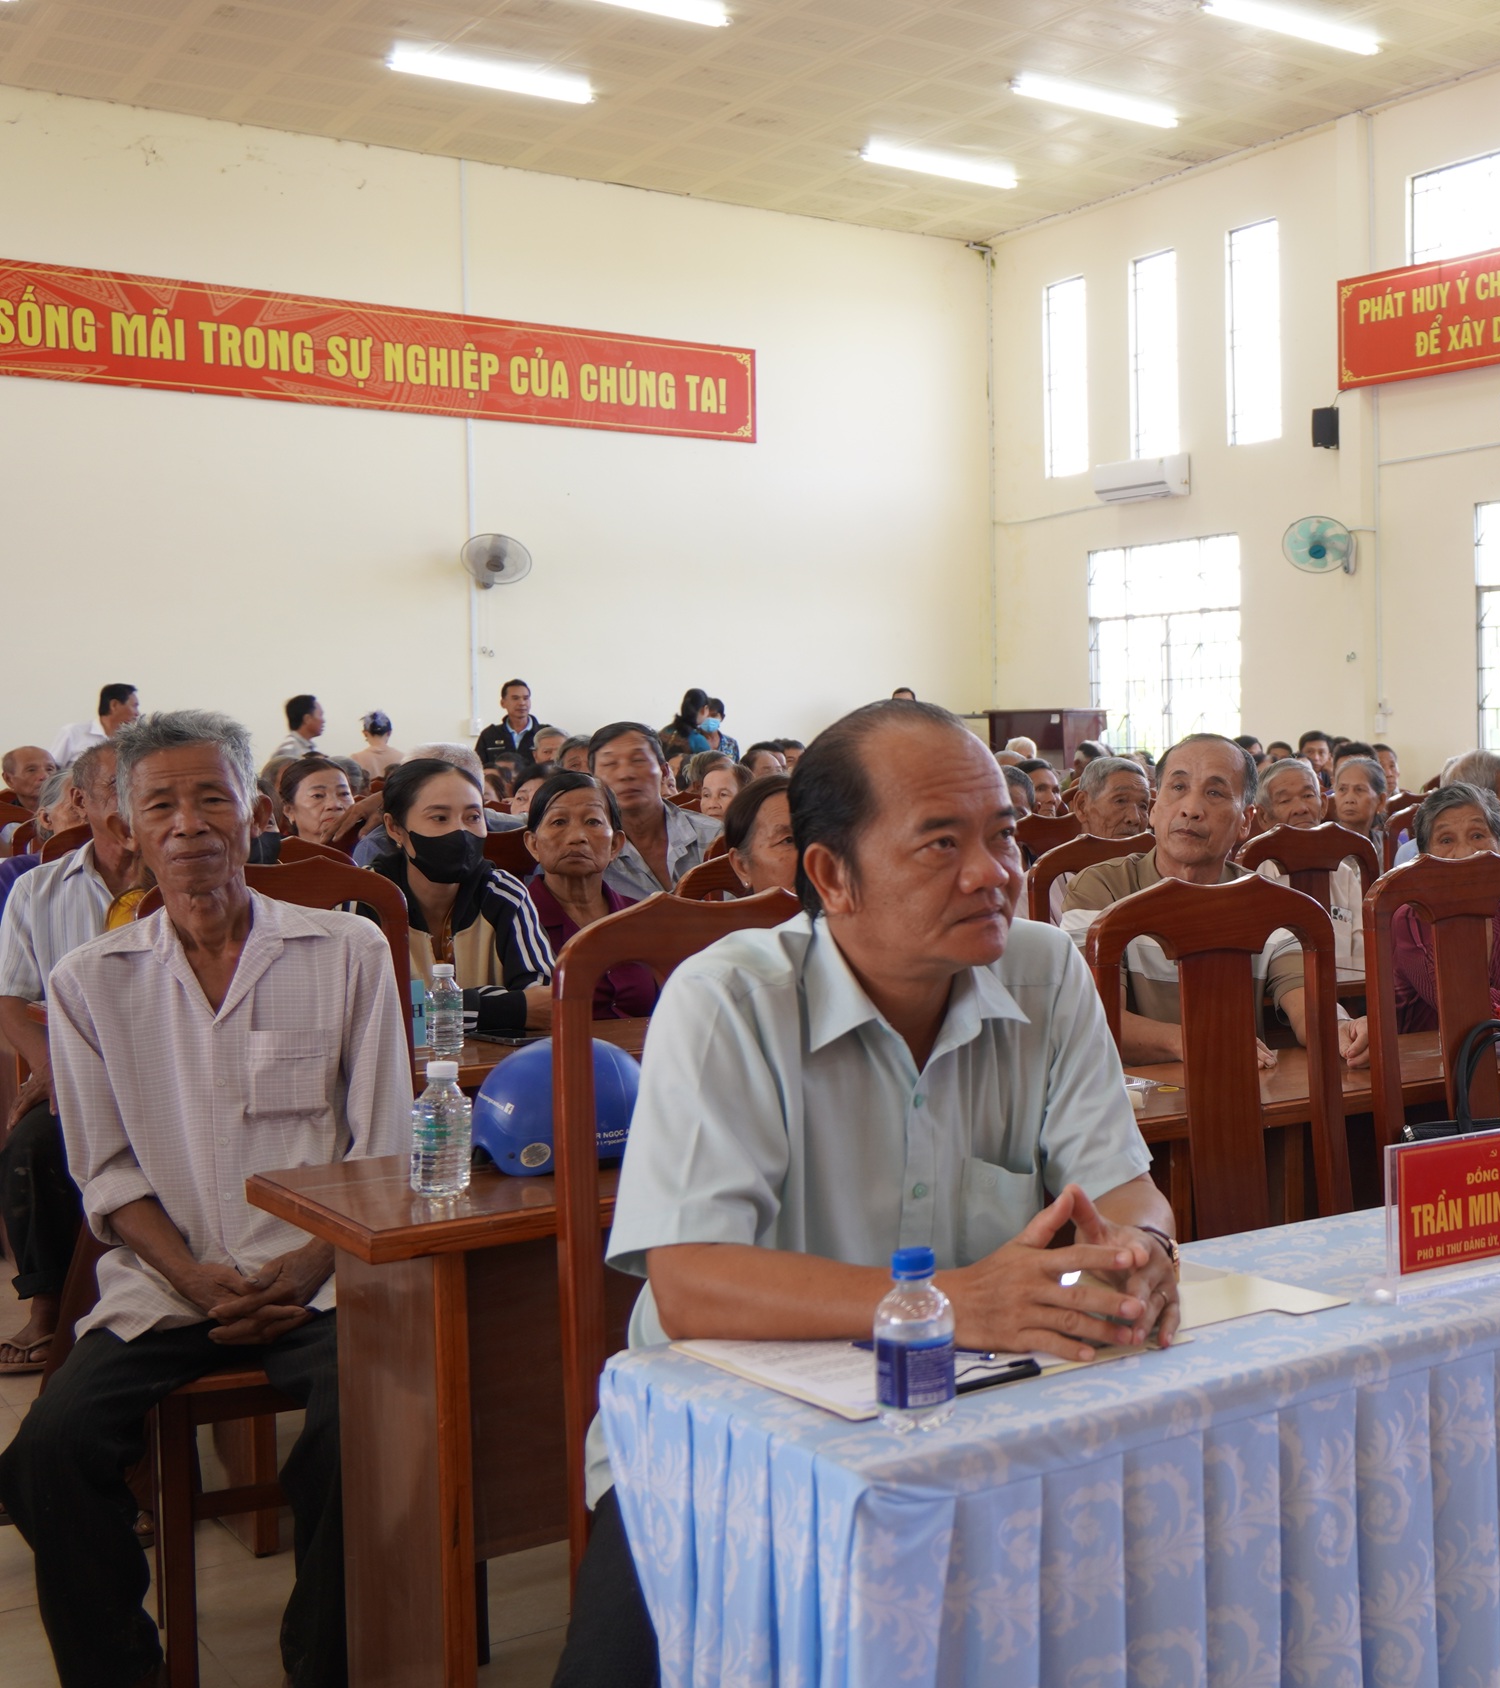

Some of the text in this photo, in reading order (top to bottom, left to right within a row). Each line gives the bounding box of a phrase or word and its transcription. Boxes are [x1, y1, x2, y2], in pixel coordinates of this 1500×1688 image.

[1358, 289, 1406, 325] PHÁT
[1411, 281, 1451, 314] HUY
[1456, 273, 1470, 305] Ý
[0, 285, 728, 415] SỐNG MÃI TRONG SỰ NGHIỆP CỦA CHÚNG TA!
[1415, 313, 1443, 357] ĐỂ
[1447, 319, 1486, 352] XÂY
[1466, 1165, 1499, 1185] ĐỒNG
[1410, 1188, 1463, 1238] TRẦN
[1416, 1248, 1434, 1262] PHÓ
[1436, 1243, 1445, 1257] BÍ
[1446, 1241, 1463, 1256] THƯ
[1463, 1236, 1487, 1252] ĐẢNG
[1487, 1232, 1500, 1247] ỦY,
